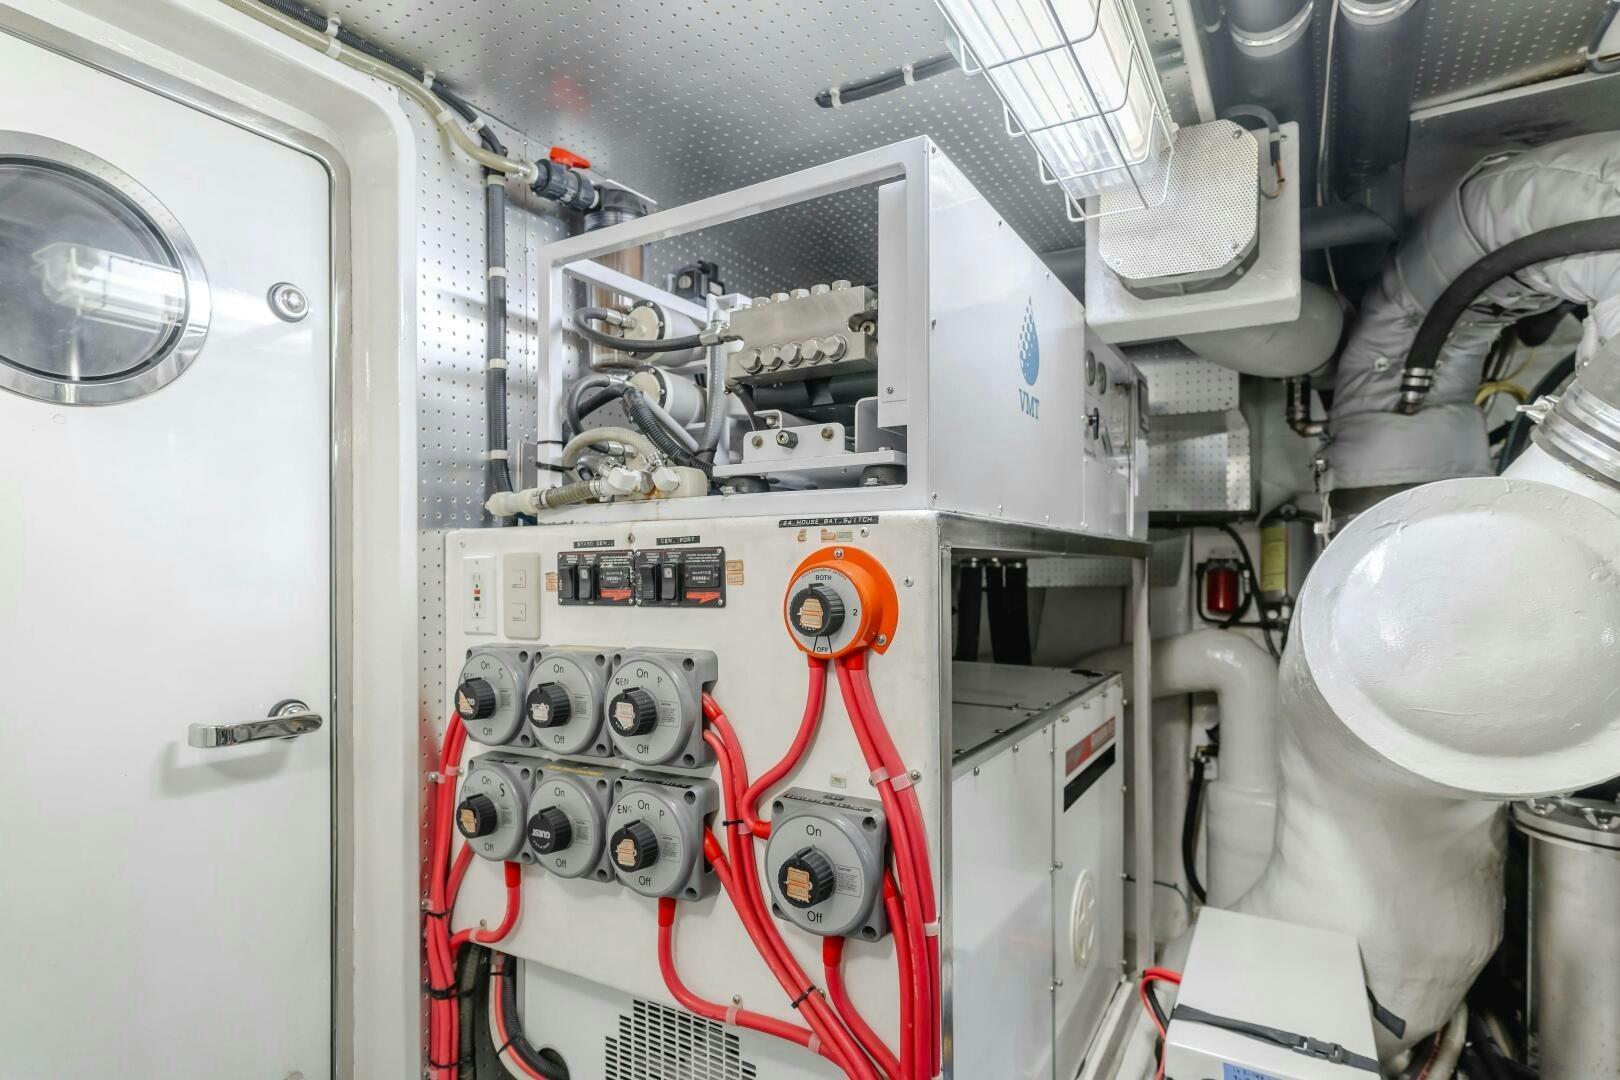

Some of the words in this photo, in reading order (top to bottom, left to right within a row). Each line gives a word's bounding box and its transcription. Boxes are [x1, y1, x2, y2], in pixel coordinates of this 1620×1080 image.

[1018, 388, 1040, 420] VMT
[852, 608, 858, 616] 2
[480, 661, 491, 671] On
[553, 664, 565, 674] On
[636, 668, 649, 679] On
[482, 727, 493, 737] Off
[553, 734, 565, 745] Off
[636, 743, 650, 754] Off
[481, 775, 492, 785] On
[554, 787, 565, 797] On
[637, 799, 650, 811] On
[659, 809, 665, 822] P
[805, 824, 822, 838] On
[483, 842, 494, 852] Off
[555, 857, 567, 869] Off
[638, 875, 651, 887] Off
[806, 910, 823, 923] Off
